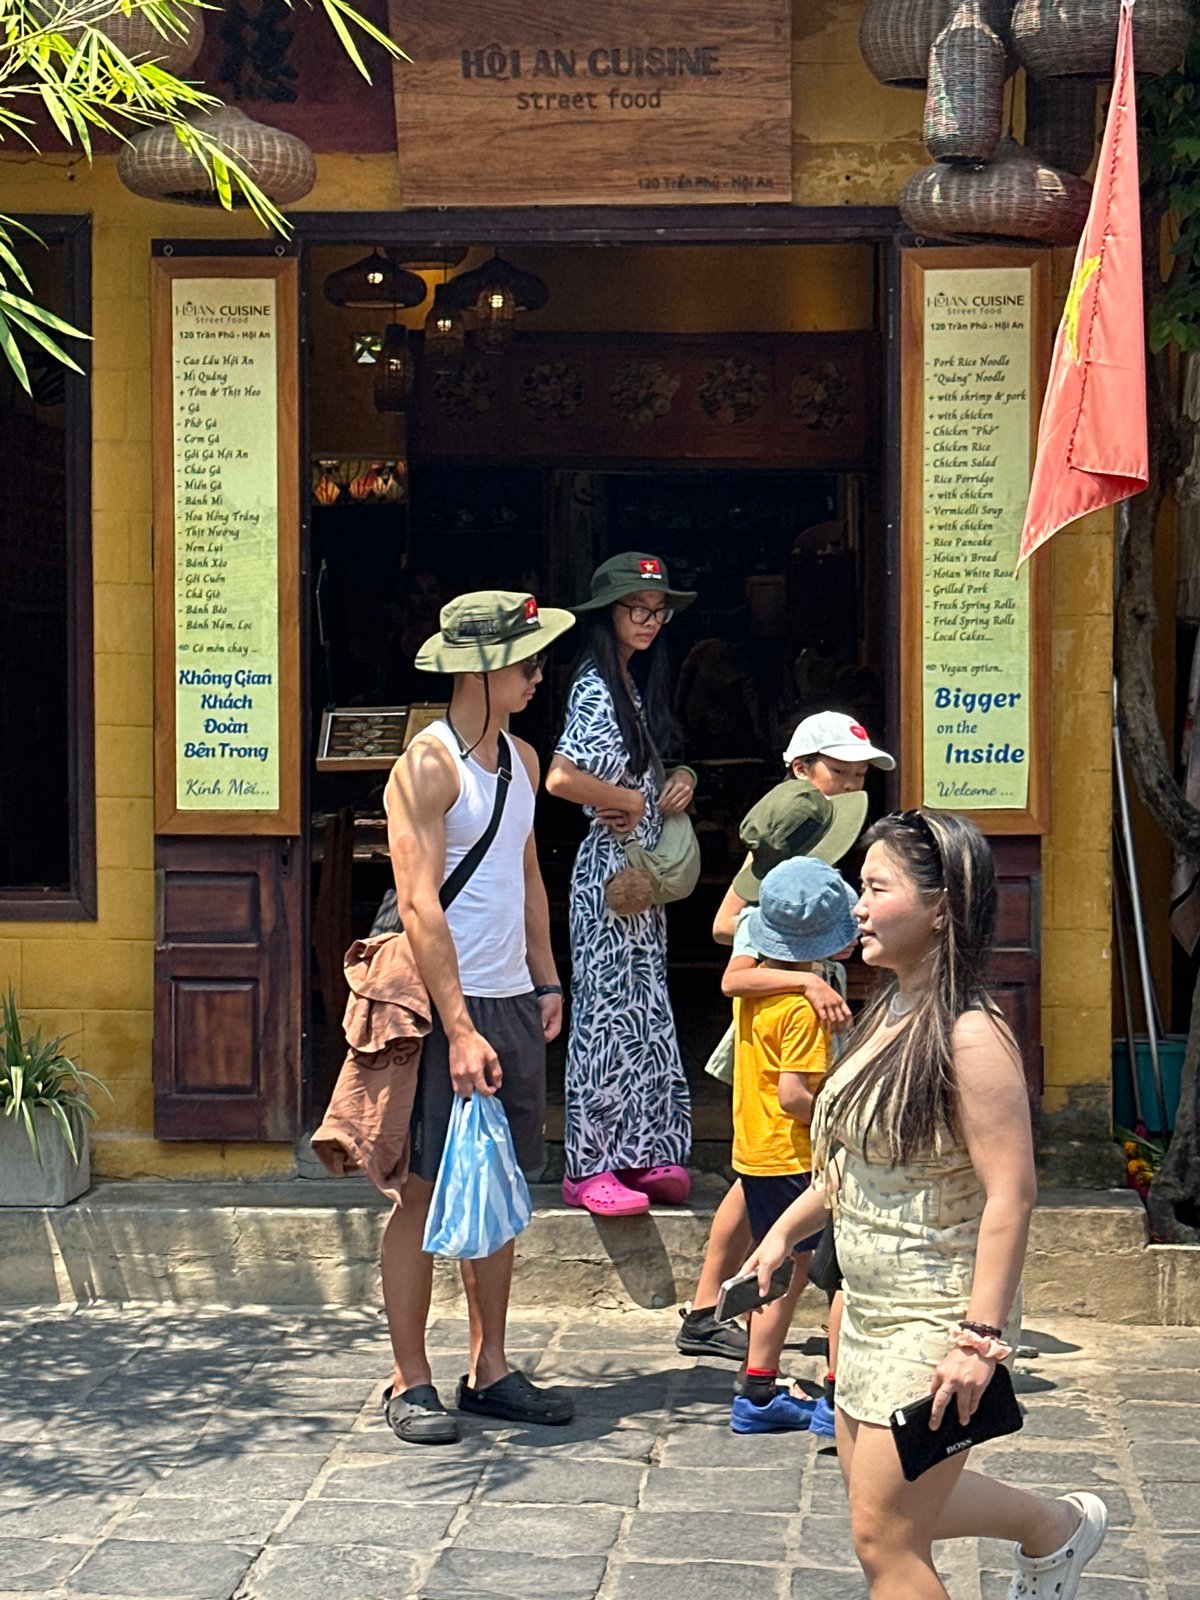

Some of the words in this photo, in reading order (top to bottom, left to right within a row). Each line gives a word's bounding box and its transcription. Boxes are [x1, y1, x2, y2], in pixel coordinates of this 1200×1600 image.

[533, 50, 576, 78] AN
[588, 48, 721, 77] CUISINE
[608, 87, 660, 109] food
[972, 295, 1024, 306] CUISINE
[220, 306, 270, 315] CUISINE
[183, 356, 199, 365] Cao
[241, 356, 254, 365] An
[934, 356, 954, 367] Pork
[958, 358, 976, 366] Rice
[980, 354, 1010, 366] Noodle
[975, 371, 1005, 382] Noodle
[244, 385, 261, 396] Heo
[938, 390, 957, 401] with
[960, 390, 992, 405] shrimp
[1003, 389, 1026, 404] pork
[938, 410, 957, 420] with
[960, 409, 993, 420] chicken
[933, 426, 968, 436] Chicken
[933, 442, 968, 452] Chicken
[972, 443, 991, 451] Rice
[236, 450, 248, 459] An
[933, 457, 968, 468] Chicken
[971, 457, 997, 467] Salad
[933, 475, 952, 484] Rice
[955, 472, 993, 488] Porridge
[937, 489, 957, 499] with
[960, 488, 993, 499] chicken
[185, 496, 207, 505] Bánh
[185, 512, 202, 521] Hoa
[934, 504, 978, 515] Vermicelli
[981, 506, 1003, 518] Soup
[937, 520, 957, 530] with
[960, 520, 993, 530] chicken
[933, 538, 952, 546] Rice
[955, 536, 992, 546] Pancake
[185, 542, 203, 552] Nem
[933, 552, 967, 562] Hoian's
[971, 552, 998, 562] Bread
[185, 558, 208, 568] Bánh
[933, 568, 960, 578] Hoian
[964, 568, 990, 578] White
[993, 568, 1014, 578] Rose
[933, 584, 963, 596] Grilled
[967, 583, 988, 593] Pork
[186, 605, 208, 614] Bánh
[933, 599, 957, 609] Fresh
[960, 601, 991, 613] Spring
[994, 599, 1015, 609] Rolls
[186, 620, 208, 629] Bánh
[933, 615, 957, 626] Fried
[959, 617, 990, 629] Spring
[993, 615, 1015, 625] Rolls
[933, 632, 956, 641] Local
[193, 644, 204, 652] Có
[941, 664, 967, 677] Vegan
[179, 669, 232, 688] Không
[235, 670, 272, 688] Gian
[201, 694, 252, 709] Khách
[935, 687, 1021, 713] Bigger
[204, 717, 248, 733] Đoàn
[937, 724, 953, 734] on
[956, 720, 977, 733] the
[184, 743, 215, 758] Bên
[218, 743, 268, 761] Trong
[946, 743, 1024, 764] Inside
[186, 779, 223, 796] Kính
[937, 781, 997, 797] Welcome
